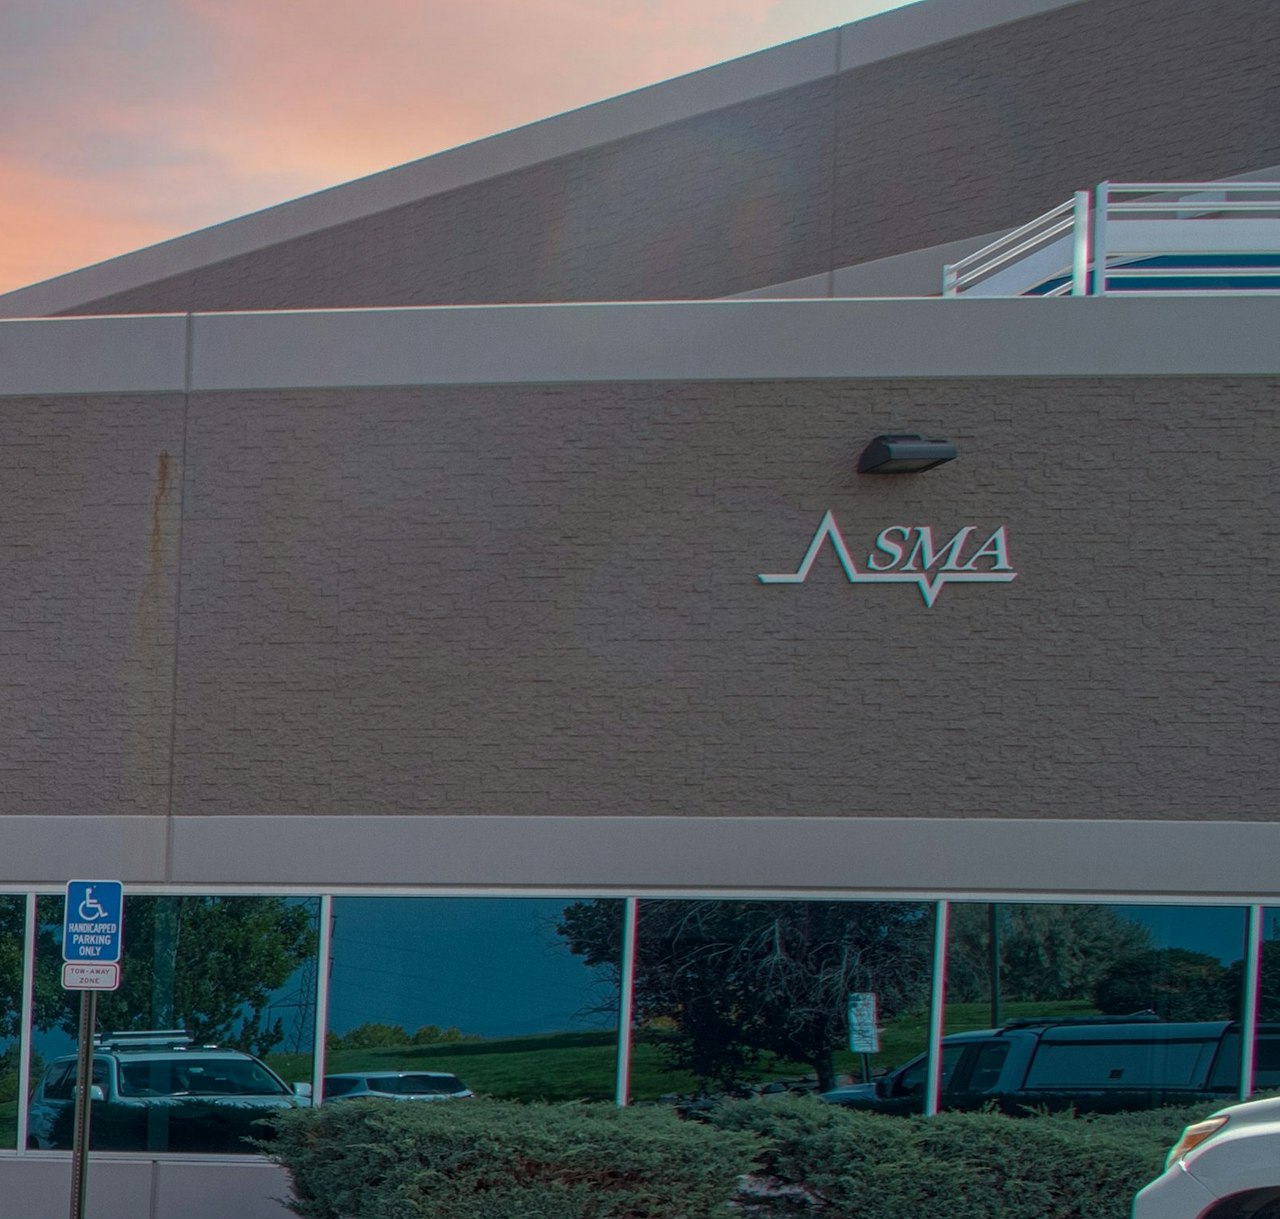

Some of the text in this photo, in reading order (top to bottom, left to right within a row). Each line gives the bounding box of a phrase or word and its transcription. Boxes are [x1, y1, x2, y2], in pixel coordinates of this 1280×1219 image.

[68, 922, 117, 933] HANDICAPPED
[72, 934, 112, 945] PARKING
[79, 946, 102, 956] ONLY
